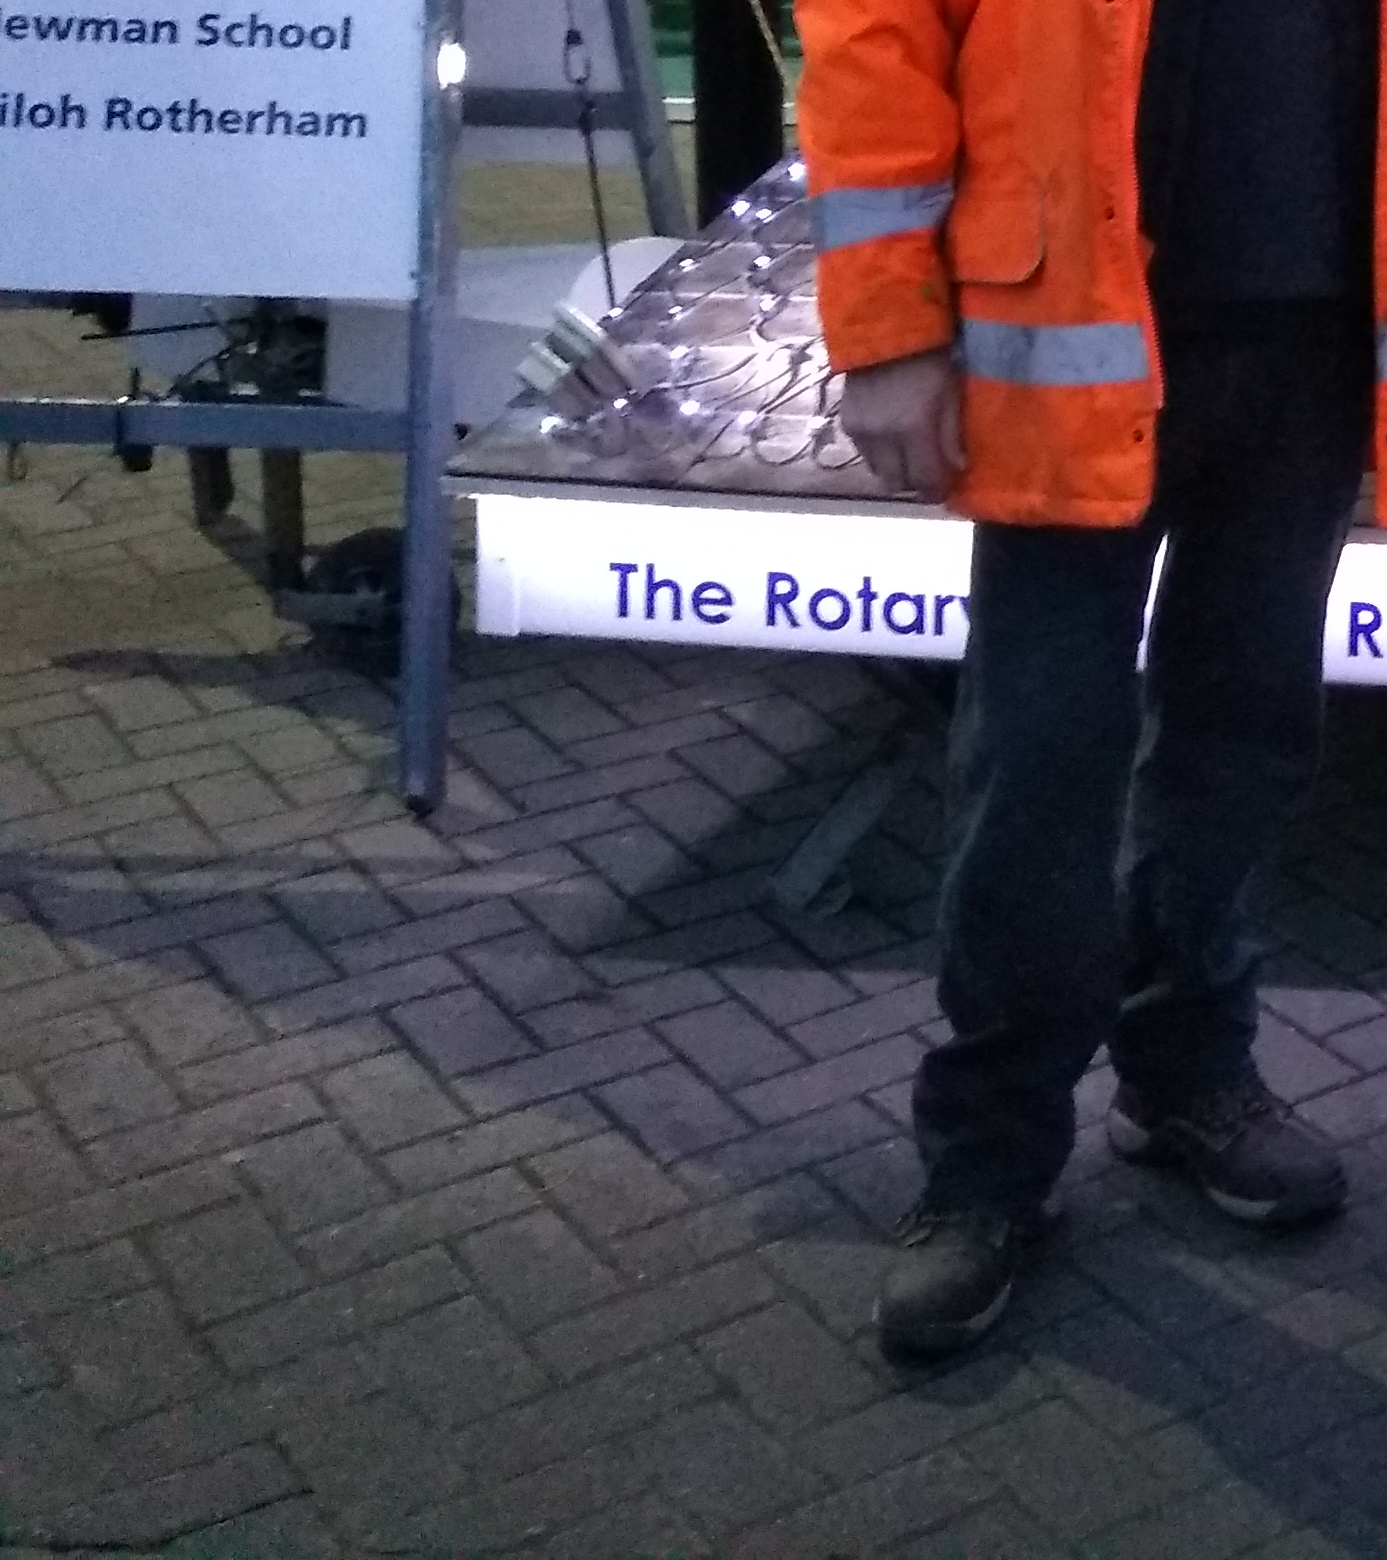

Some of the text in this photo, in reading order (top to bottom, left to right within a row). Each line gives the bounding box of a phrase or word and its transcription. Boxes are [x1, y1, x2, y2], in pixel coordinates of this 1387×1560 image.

[0, 10, 353, 51] ewman School
[0, 92, 369, 139] iloh Rotherham
[608, 561, 971, 636] The Rotar
